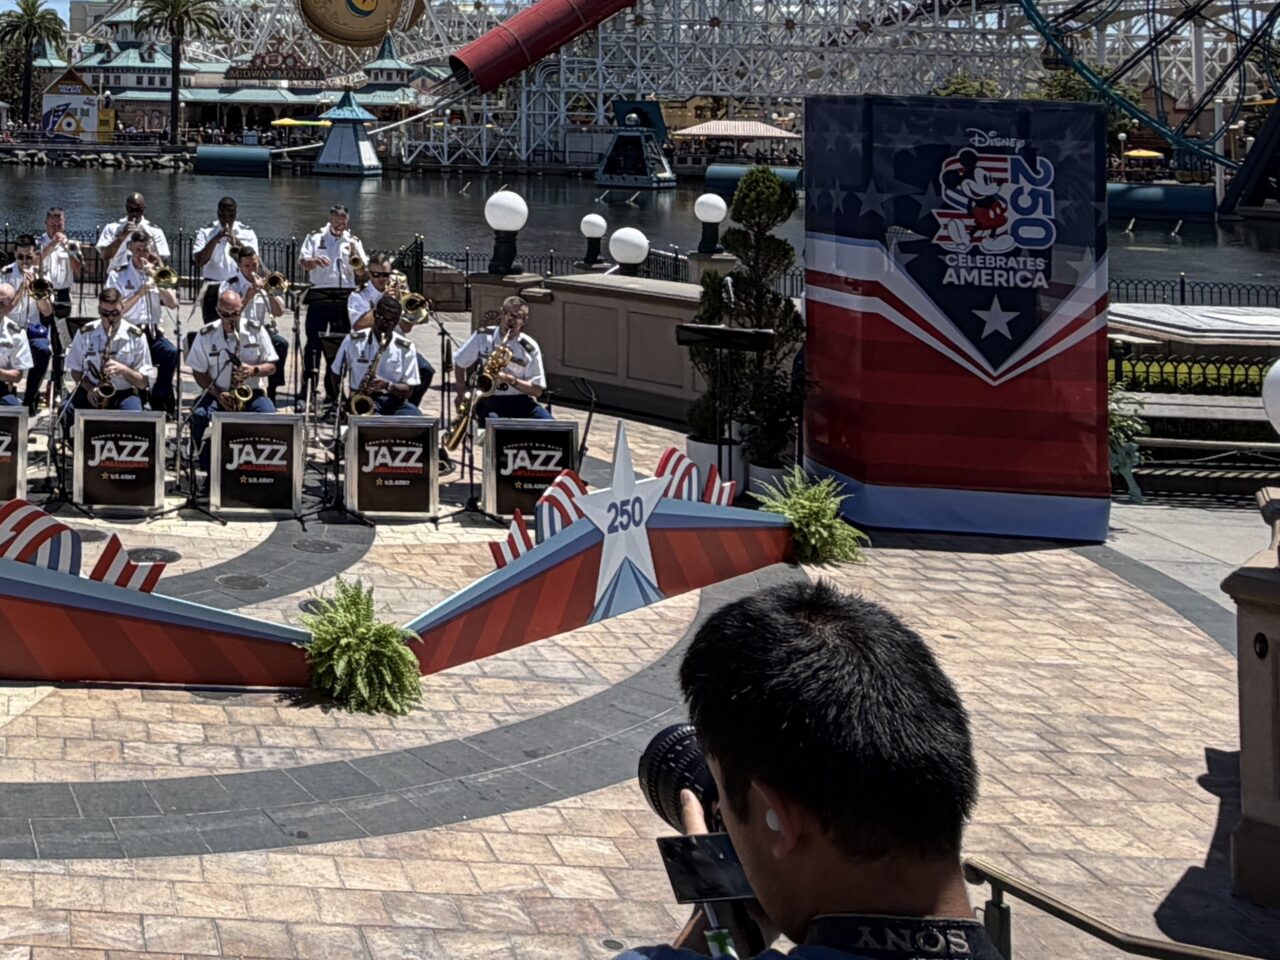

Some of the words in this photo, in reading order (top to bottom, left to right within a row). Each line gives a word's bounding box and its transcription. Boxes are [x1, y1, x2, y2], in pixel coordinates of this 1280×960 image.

[231, 69, 273, 78] MIDWAY
[966, 128, 1025, 153] Disney
[1010, 156, 1056, 249] 250
[945, 253, 1046, 271] CELEBRATES
[942, 267, 1049, 289] AMERICA
[87, 440, 149, 466] JAZZ
[225, 444, 288, 470] JAZZ
[361, 446, 423, 472] JAZZ
[500, 449, 563, 476] JAZZ
[606, 496, 643, 534] 250
[855, 926, 970, 954] SONY
